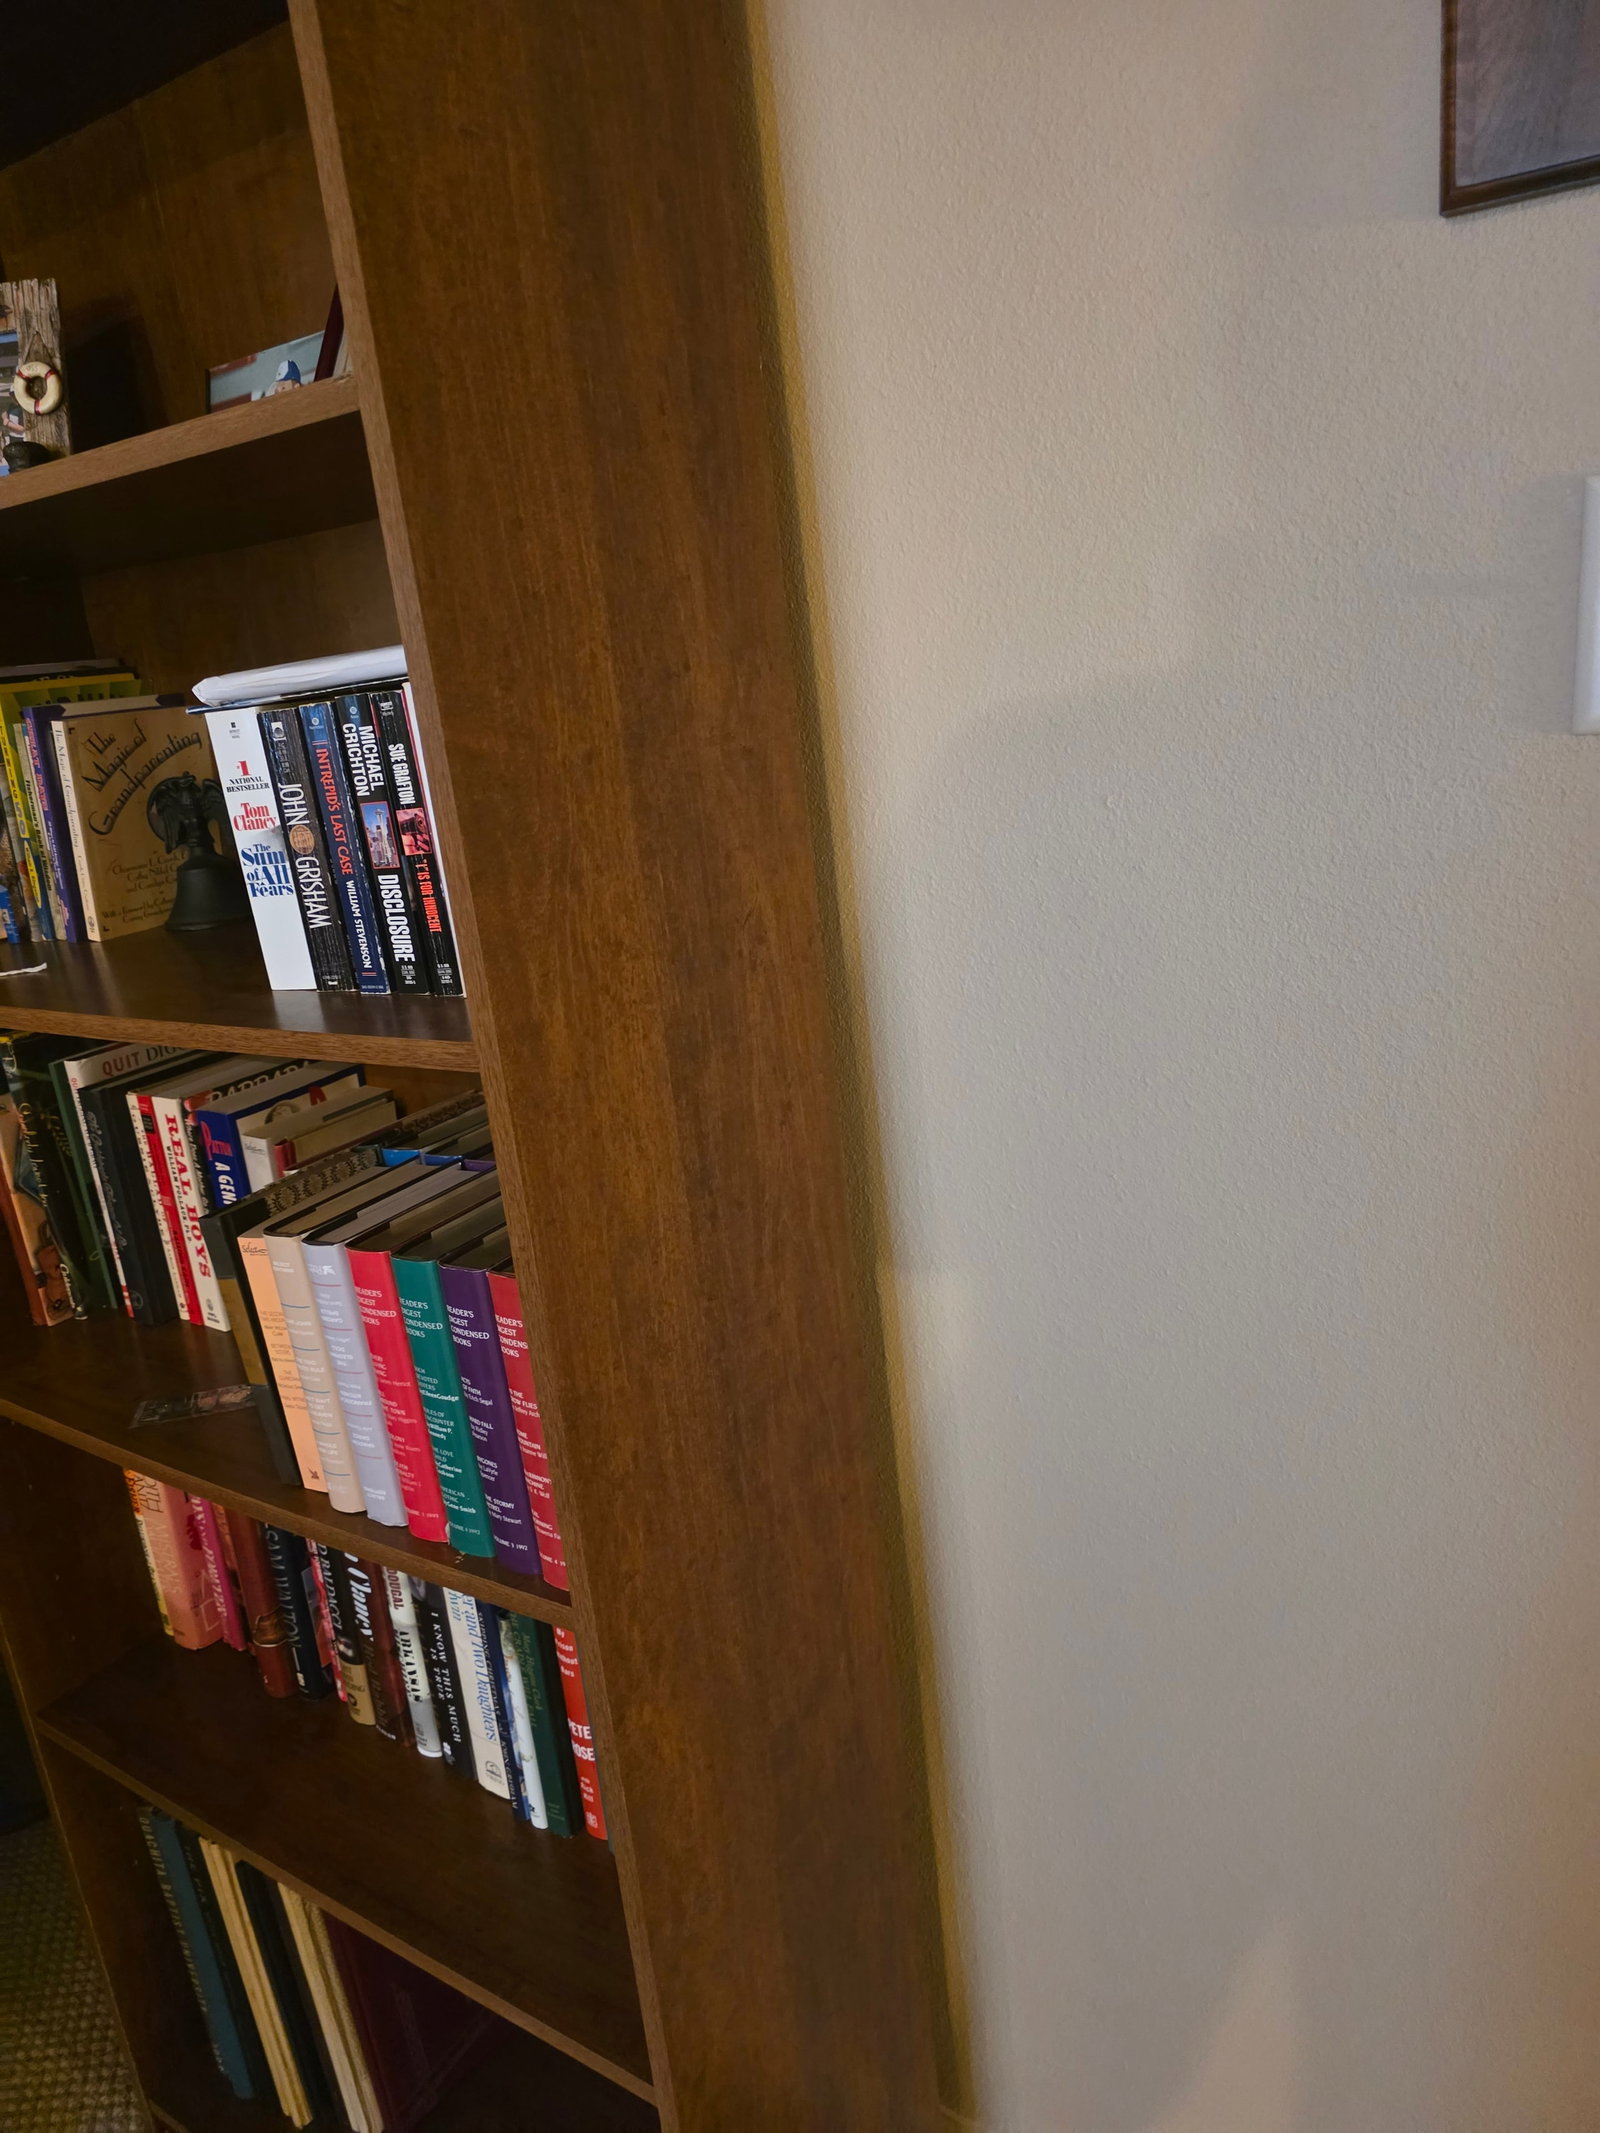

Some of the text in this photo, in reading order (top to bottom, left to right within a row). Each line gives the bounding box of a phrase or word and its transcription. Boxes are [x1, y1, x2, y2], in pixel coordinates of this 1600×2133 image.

[81, 732, 116, 756] The
[81, 718, 147, 792] Magic of
[342, 723, 370, 797] CRICHTON
[358, 725, 385, 791] MICHAEL
[88, 732, 202, 835] Grandparenting
[226, 783, 270, 793] BESTSELLER
[229, 775, 264, 785] NATIONAL
[315, 748, 342, 812] INTREPID'S
[388, 743, 416, 805] SUE GRAFTON
[233, 815, 277, 833] Clancy
[240, 803, 270, 819] Tom
[330, 815, 347, 843] LAST
[240, 848, 287, 866] Sum
[252, 844, 271, 852] The
[278, 783, 311, 826] JOHN
[295, 856, 333, 929] GRISHAM
[338, 846, 354, 875] CASE
[247, 864, 291, 884] of All
[249, 882, 294, 897] Fears
[417, 871, 431, 881] IS
[420, 881, 434, 897] FOR
[345, 880, 362, 917] WILLIAM
[422, 896, 443, 933] INNOCENT
[378, 874, 416, 962] DISCLOSURE
[354, 919, 373, 969] STEVENSON
[103, 1052, 139, 1076] QUIT
[165, 1145, 179, 1182] WILLIAM
[214, 1162, 231, 1171] A
[165, 1114, 212, 1278] REAL BOYS
[450, 1325, 490, 1340] CONDENSED
[499, 1335, 529, 1350] ONDENS
[266, 1530, 302, 1648] SAM WALTON
[321, 1554, 343, 1630] BALDACCI
[346, 1566, 374, 1642] Clancy
[386, 1568, 405, 1611] DOUGAL
[432, 1623, 447, 1662] KNOW
[430, 1647, 446, 1700] IS TRUE
[440, 1668, 455, 1700] THIS
[465, 1603, 499, 1742] and Two Daughters
[447, 1703, 462, 1743] MUCH
[567, 1717, 592, 1740] PETE
[571, 1739, 596, 1761] ROSE
